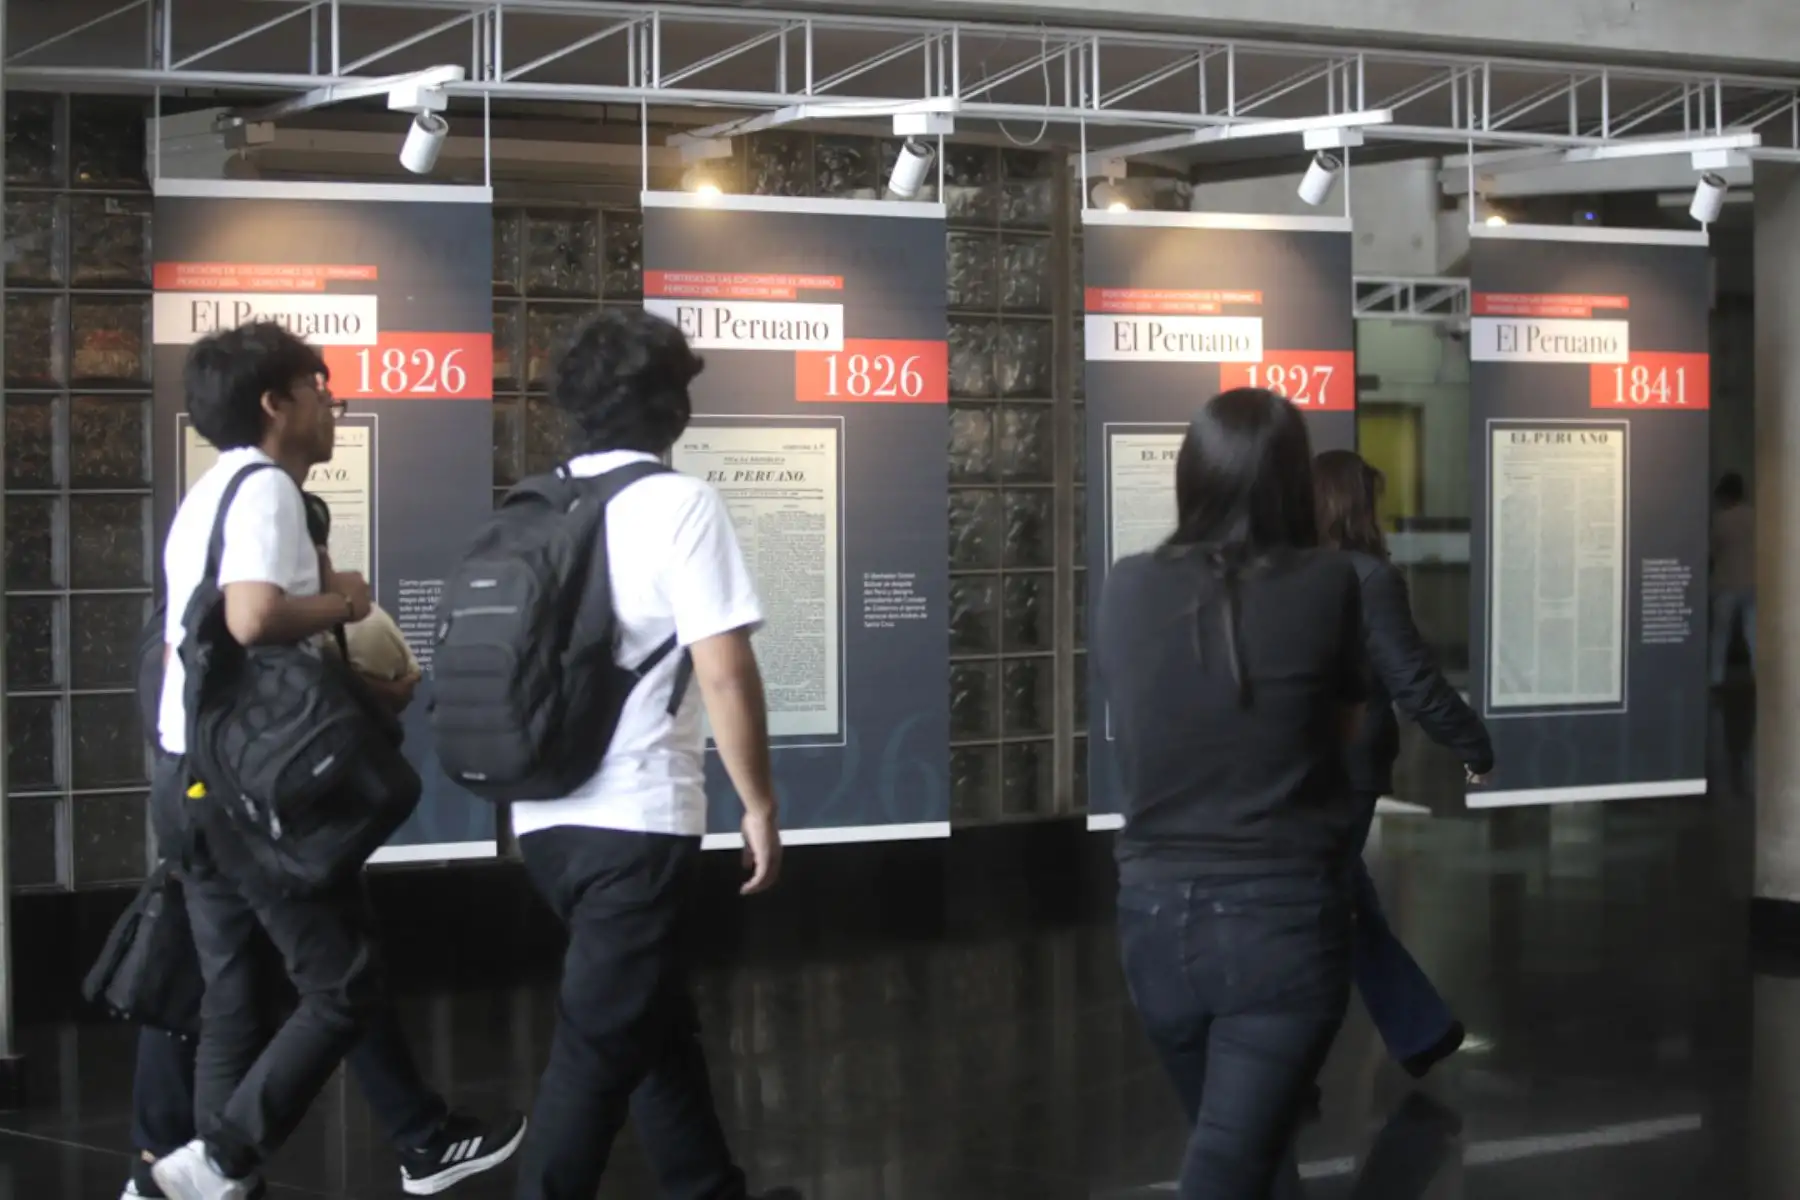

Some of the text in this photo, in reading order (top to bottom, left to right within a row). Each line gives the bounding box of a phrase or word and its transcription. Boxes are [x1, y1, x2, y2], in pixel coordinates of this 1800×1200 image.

[190, 299, 221, 333] El
[676, 306, 829, 341] El Peruano
[1113, 321, 1250, 352] El Peruano
[1496, 324, 1618, 354] El Peruano
[355, 348, 467, 394] 1826
[824, 354, 924, 398] 1826
[1244, 364, 1334, 405] 1827
[1612, 365, 1688, 405] 1841
[1510, 432, 1609, 445] EL PERUANO
[706, 470, 727, 482] EL
